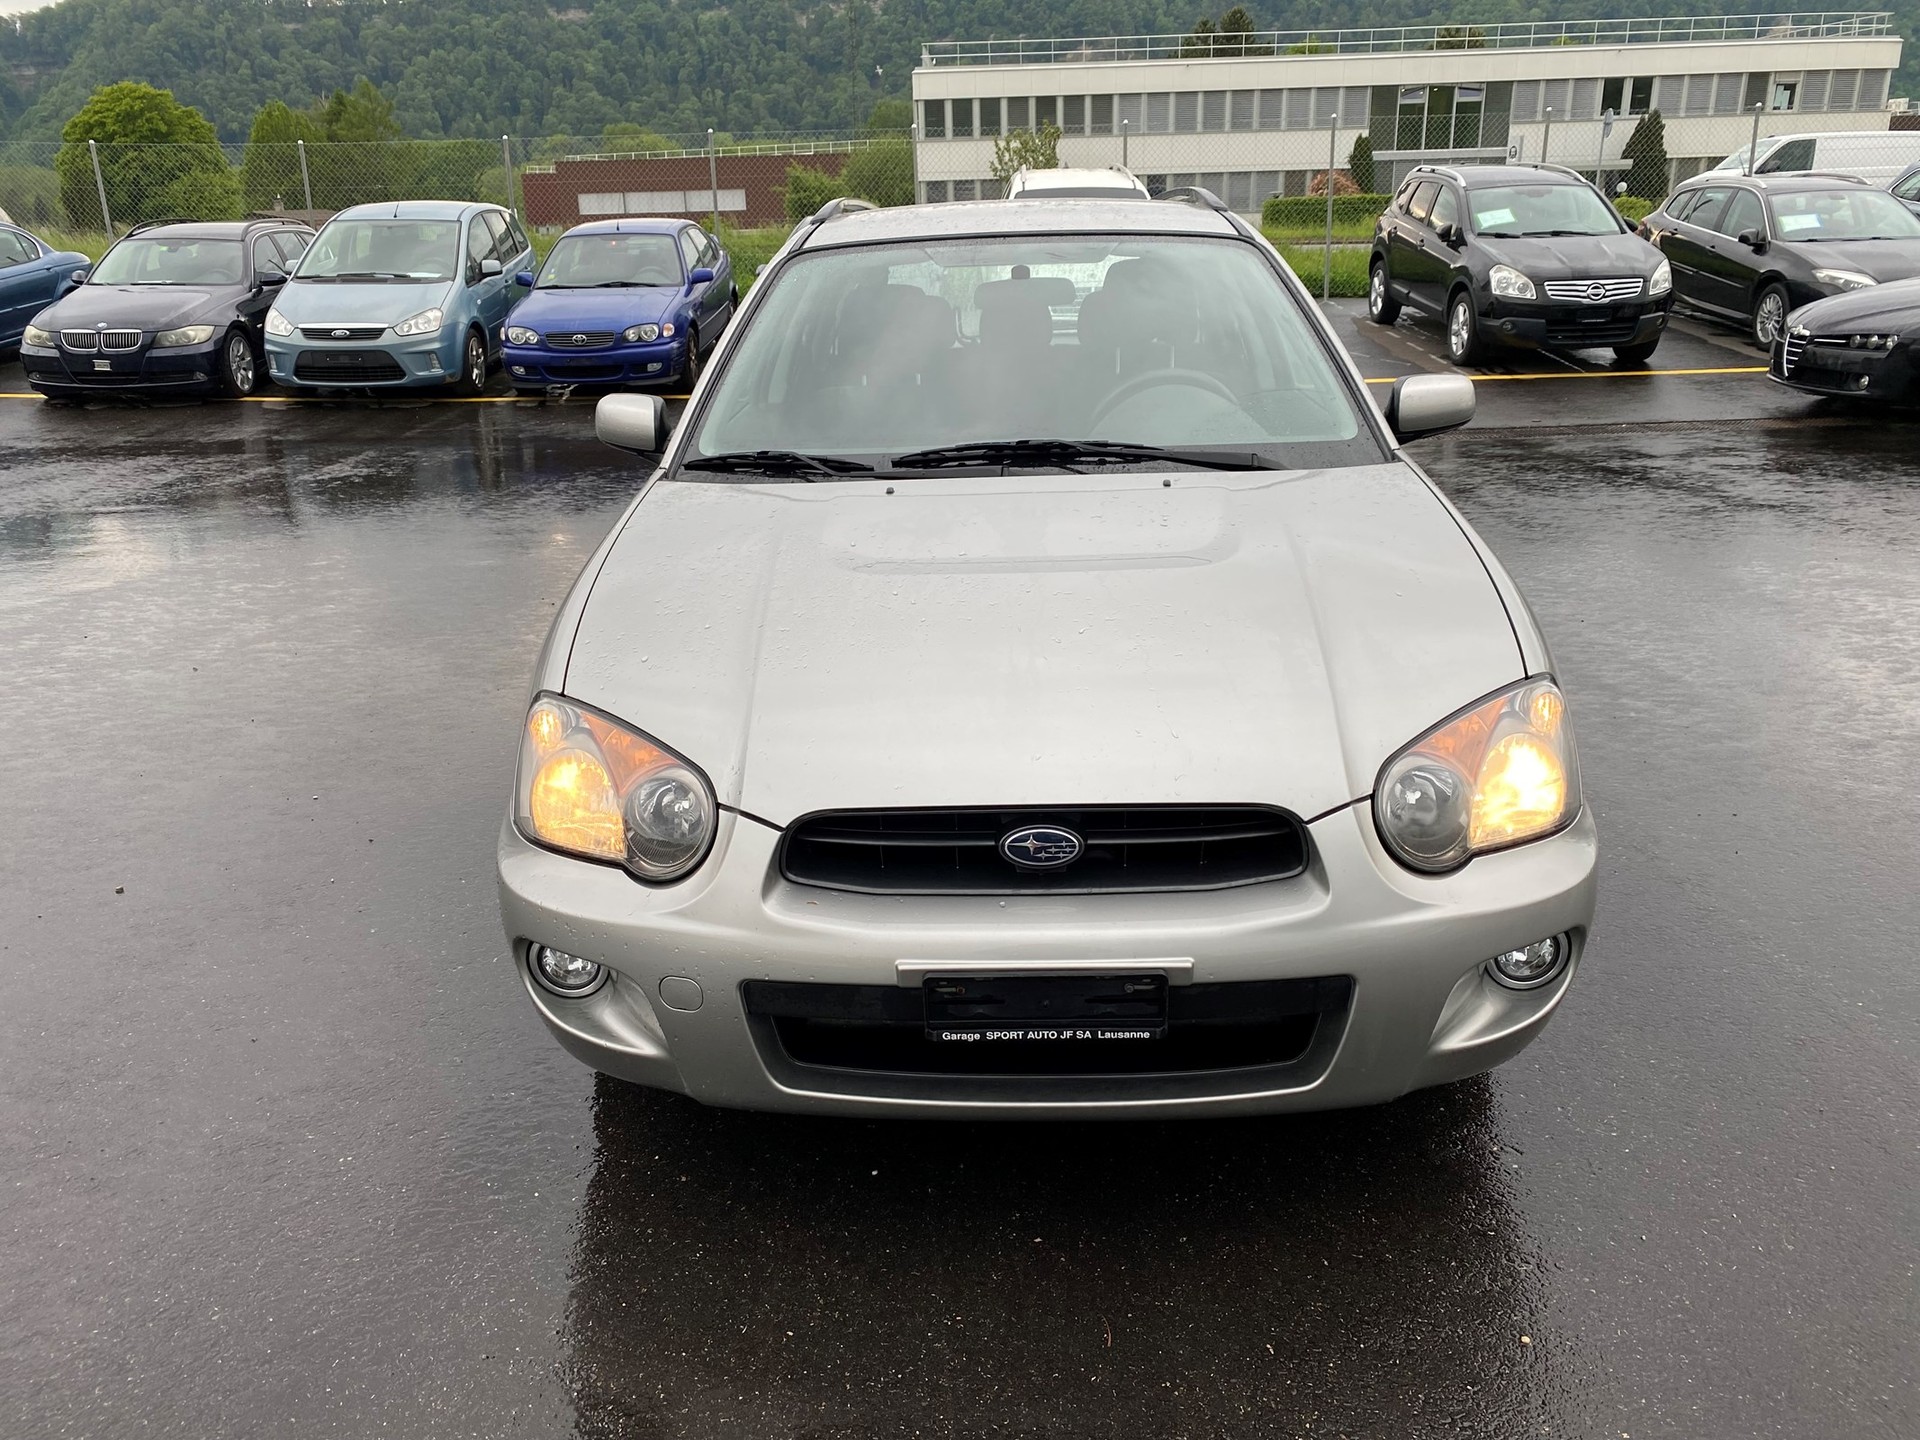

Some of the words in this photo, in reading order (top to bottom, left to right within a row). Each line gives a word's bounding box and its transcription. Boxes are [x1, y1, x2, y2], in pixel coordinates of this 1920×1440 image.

[942, 1032, 980, 1042] Garage
[986, 1031, 1024, 1040] SPORT
[1027, 1030, 1058, 1040] AUTO
[1060, 1030, 1073, 1039] JF
[1076, 1030, 1092, 1039] SA
[1098, 1030, 1150, 1039] Lausanne
